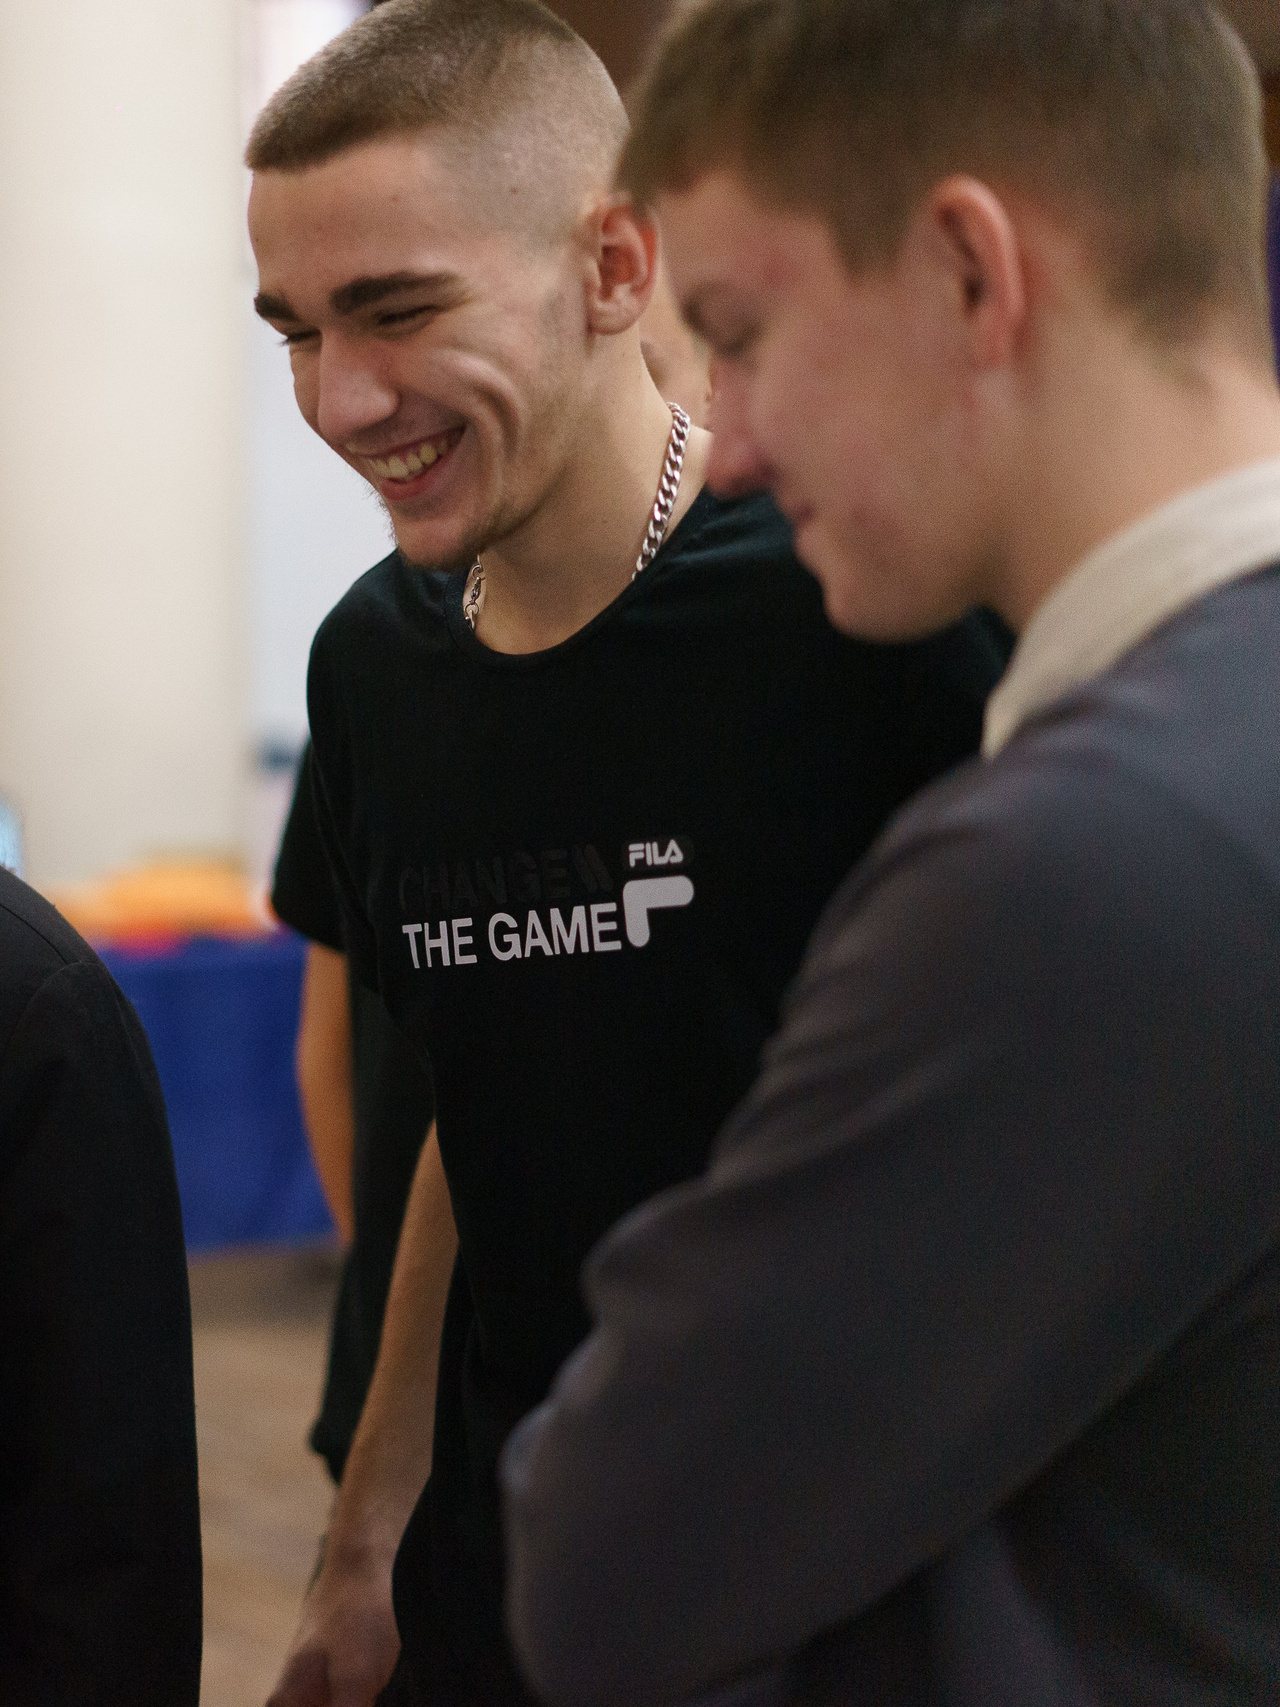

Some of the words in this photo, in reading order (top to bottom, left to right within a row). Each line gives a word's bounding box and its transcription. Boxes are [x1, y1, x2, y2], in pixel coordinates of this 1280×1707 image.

[628, 838, 684, 868] FILA
[402, 917, 477, 969] THE
[488, 901, 622, 961] GAME
